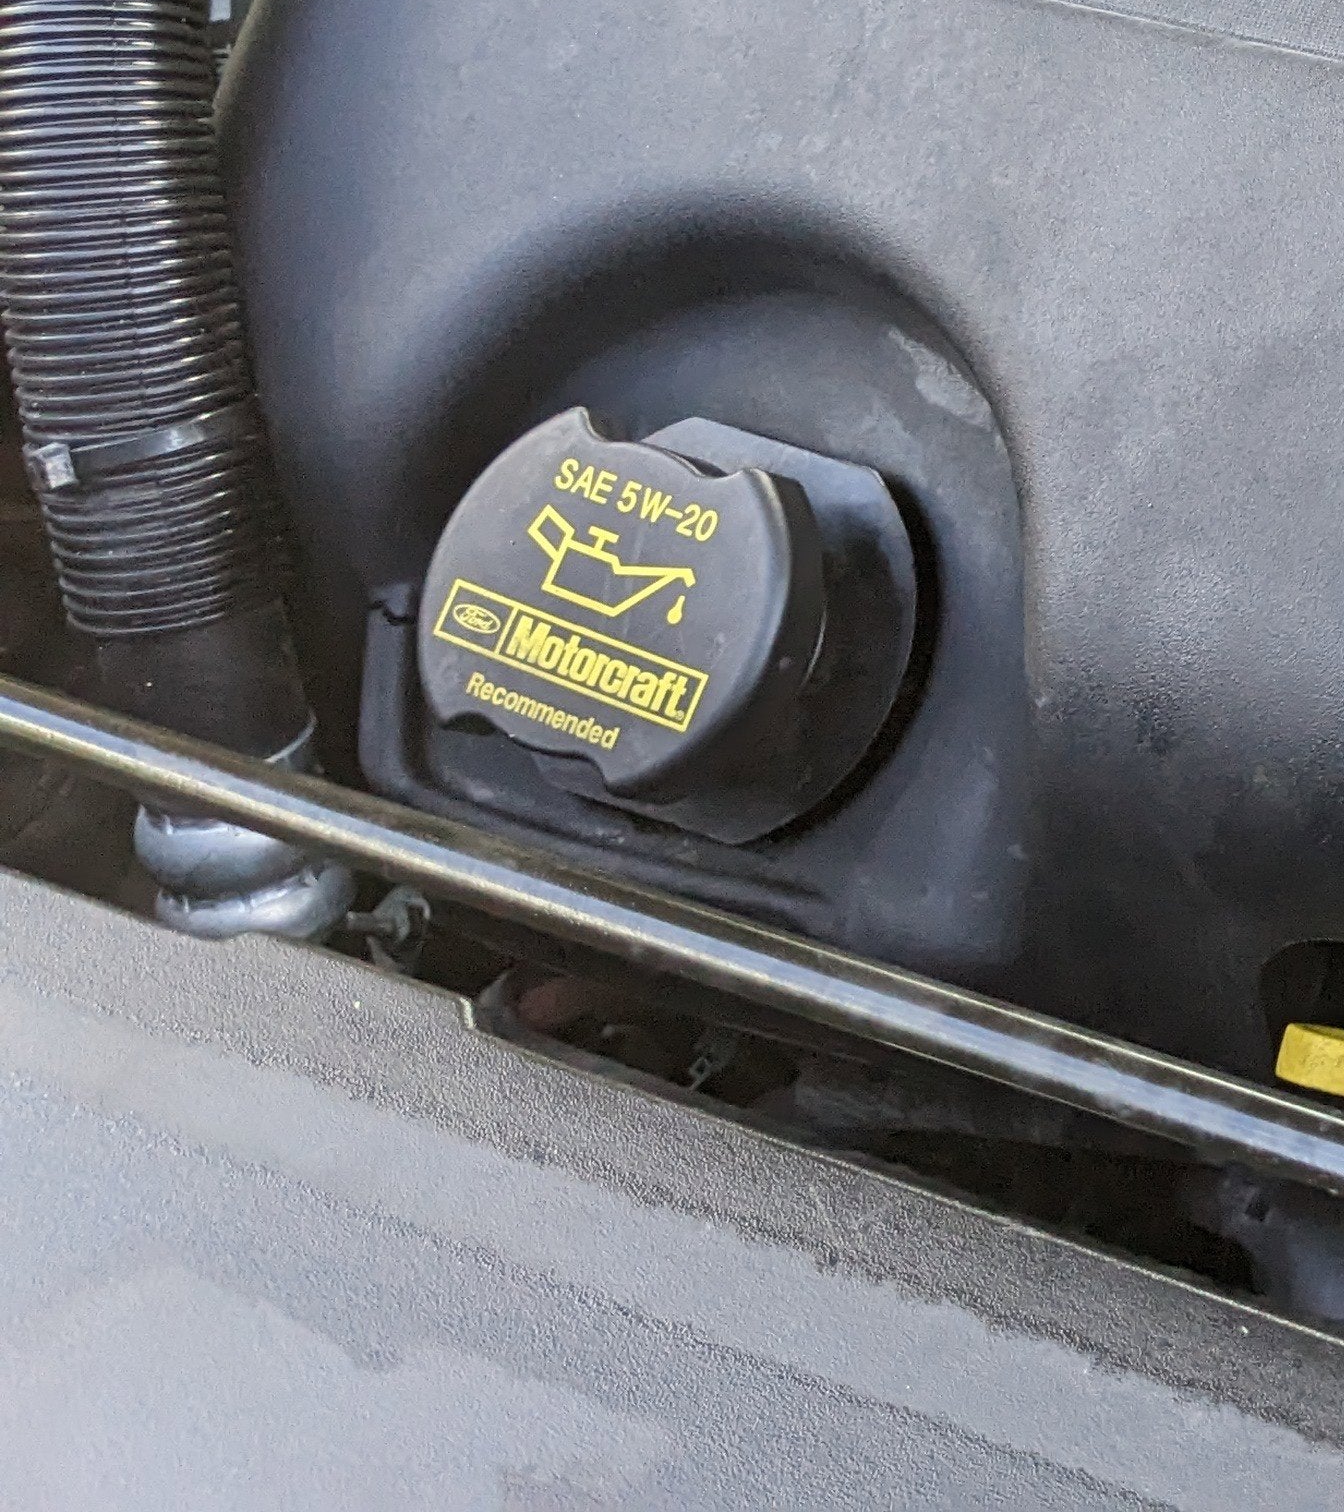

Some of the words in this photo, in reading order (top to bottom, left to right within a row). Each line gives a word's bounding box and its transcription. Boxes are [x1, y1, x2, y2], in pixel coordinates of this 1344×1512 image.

[555, 458, 617, 504] SAE
[617, 480, 718, 542] 5W-20
[458, 605, 494, 631] Ford
[505, 615, 687, 719] Motorcraft
[466, 672, 619, 750] Recommended
